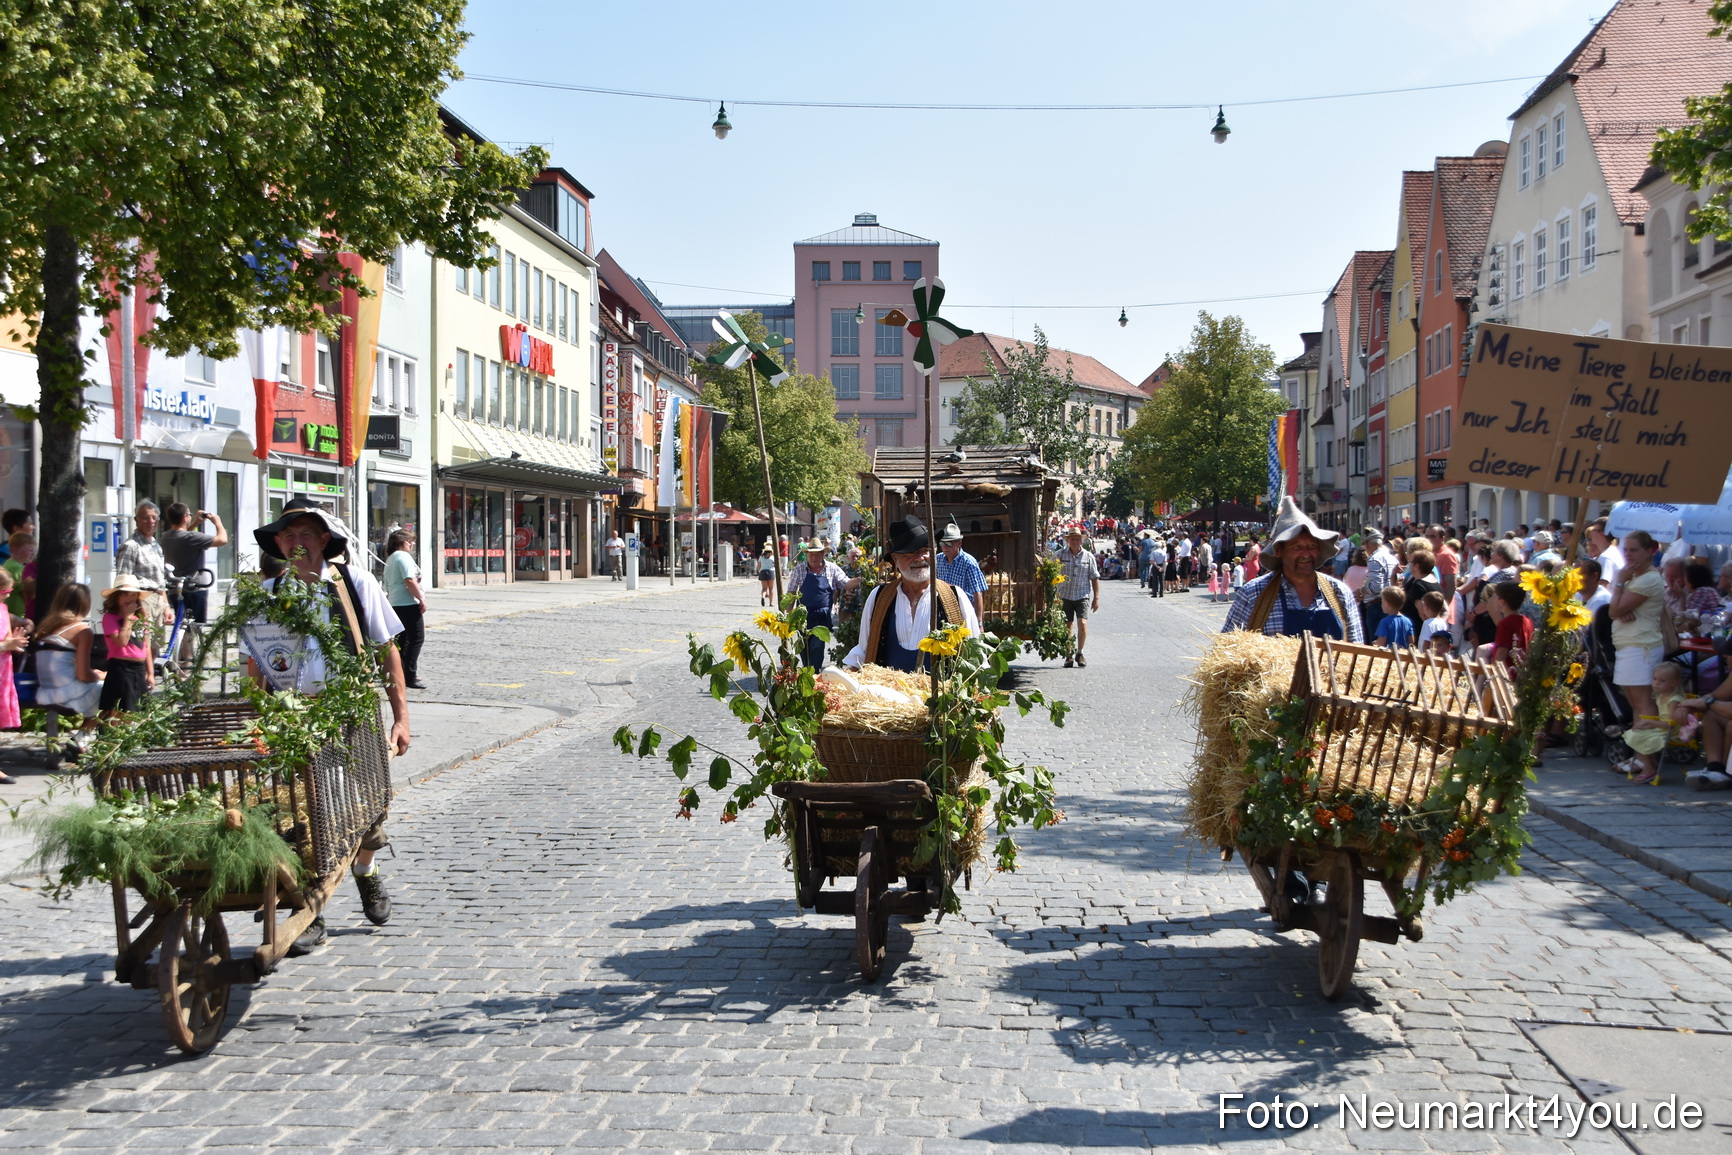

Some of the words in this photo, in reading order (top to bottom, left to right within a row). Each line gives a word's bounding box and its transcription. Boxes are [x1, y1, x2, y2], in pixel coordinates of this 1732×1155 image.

[499, 323, 555, 377] WÖHRL
[1477, 330, 1560, 372] Meine
[1573, 342, 1626, 379] Tiere
[1648, 352, 1732, 383] bleiben
[187, 391, 217, 424] lady
[605, 343, 615, 444] BÄCKEREI
[1570, 387, 1592, 407] im
[1600, 382, 1660, 416] Stall
[368, 433, 396, 442] BONITA
[1462, 411, 1499, 429] nur
[1570, 416, 1621, 444] stell
[1636, 421, 1687, 446] mich
[1468, 448, 1541, 479] dieser
[1554, 447, 1670, 498] Hitzequal
